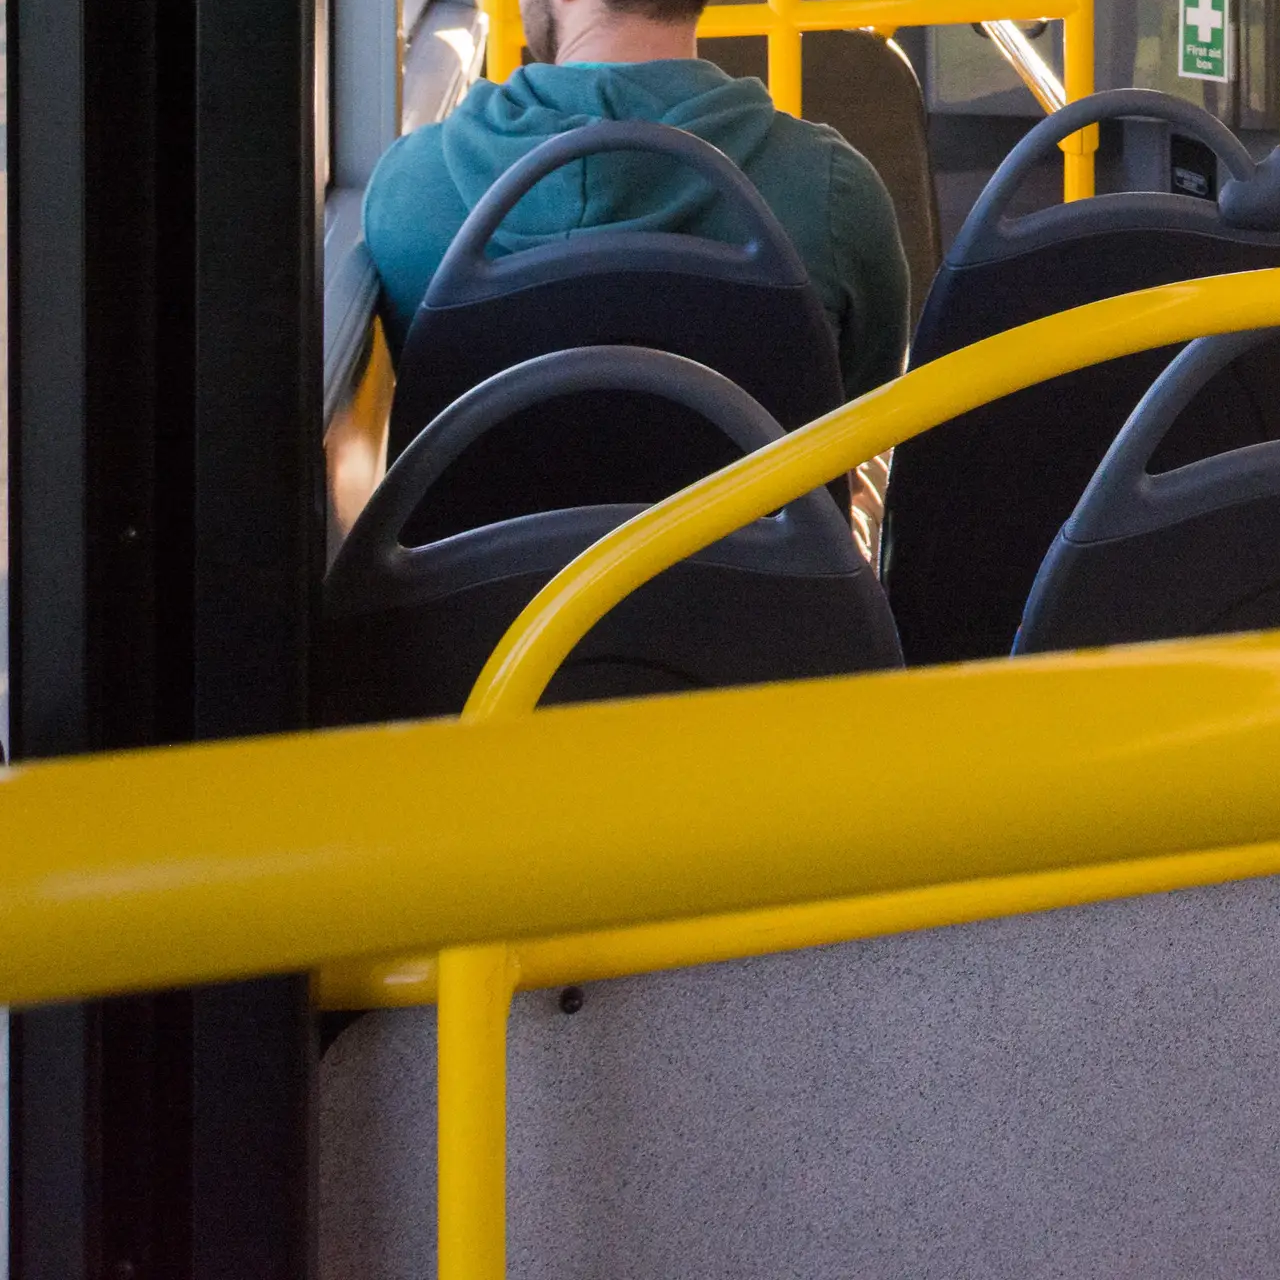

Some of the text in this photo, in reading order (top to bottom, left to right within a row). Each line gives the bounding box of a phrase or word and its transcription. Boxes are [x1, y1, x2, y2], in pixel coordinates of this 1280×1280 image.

[1186, 44, 1222, 59] First aid
[1196, 57, 1212, 70] box
